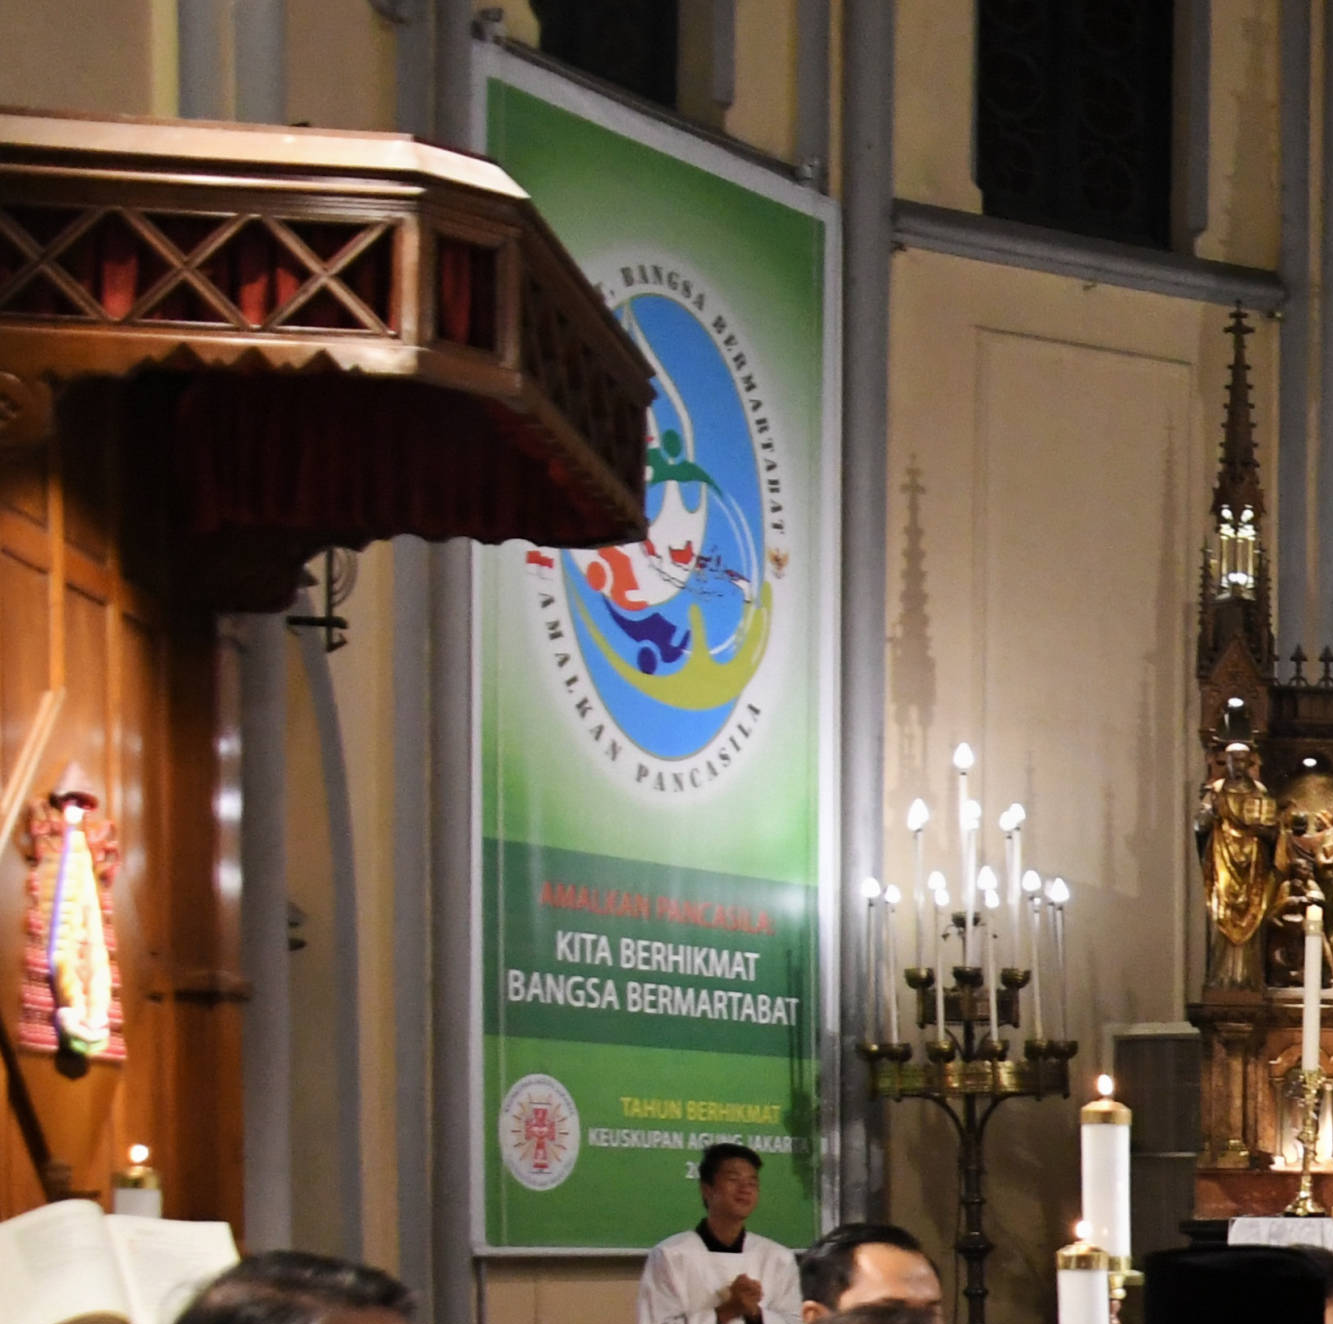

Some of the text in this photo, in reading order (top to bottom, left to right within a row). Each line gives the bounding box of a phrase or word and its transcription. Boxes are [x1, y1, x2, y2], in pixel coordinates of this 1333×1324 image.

[620, 264, 785, 535] BANGSA BERMARTABAT
[538, 592, 761, 792] AMALKAN PANCASILA
[540, 880, 650, 920] AMALKAN
[556, 930, 761, 982] KITA BERHIKMAT
[507, 968, 800, 1026] BANGSA BERMARTABAT
[620, 1097, 782, 1125] TAHUN BERHIKMAT
[588, 1127, 684, 1149] KEUSKUPAN
